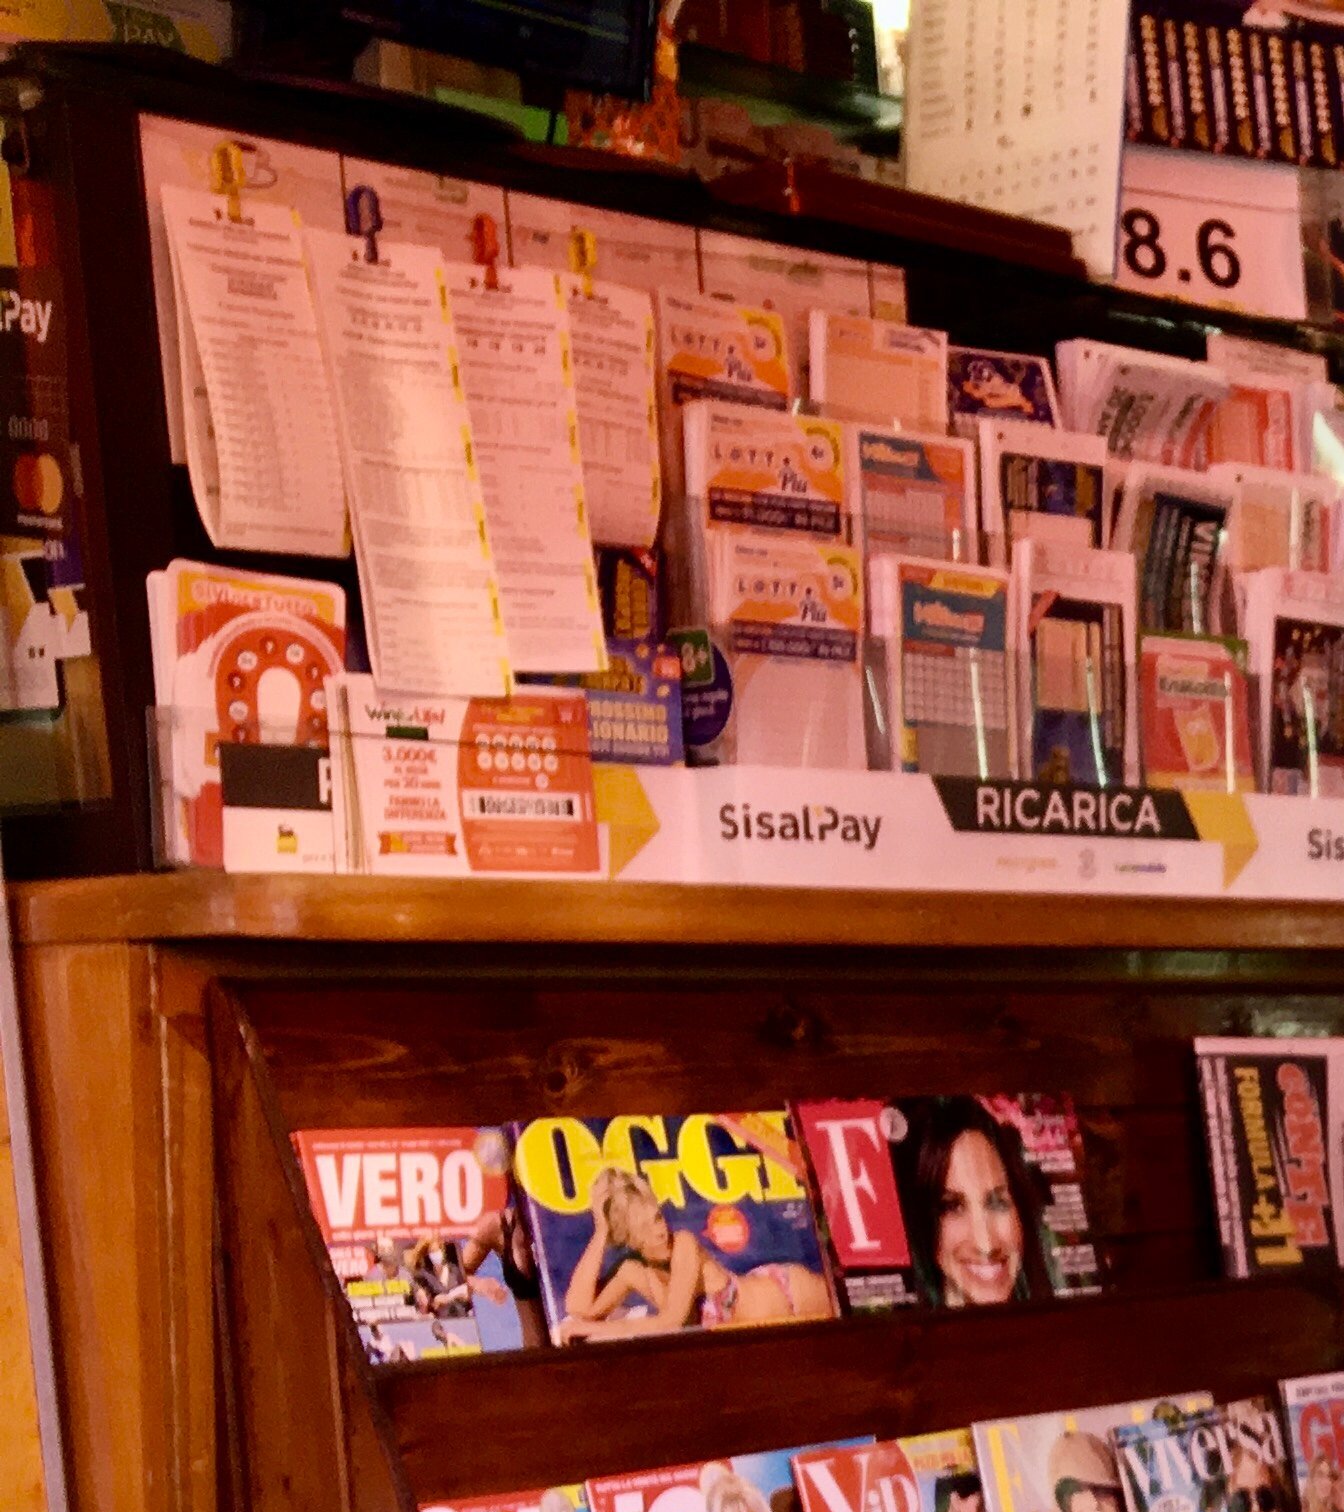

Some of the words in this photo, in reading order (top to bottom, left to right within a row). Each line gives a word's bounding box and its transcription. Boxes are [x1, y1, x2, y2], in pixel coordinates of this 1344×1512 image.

[1121, 207, 1242, 290] 8.6
[720, 803, 881, 850] SisalPay
[974, 786, 1162, 834] RICARICA
[514, 1113, 808, 1214] OGGI
[1234, 1066, 1276, 1190] FORMULA
[315, 1151, 484, 1228] VERO
[815, 1117, 883, 1253] F
